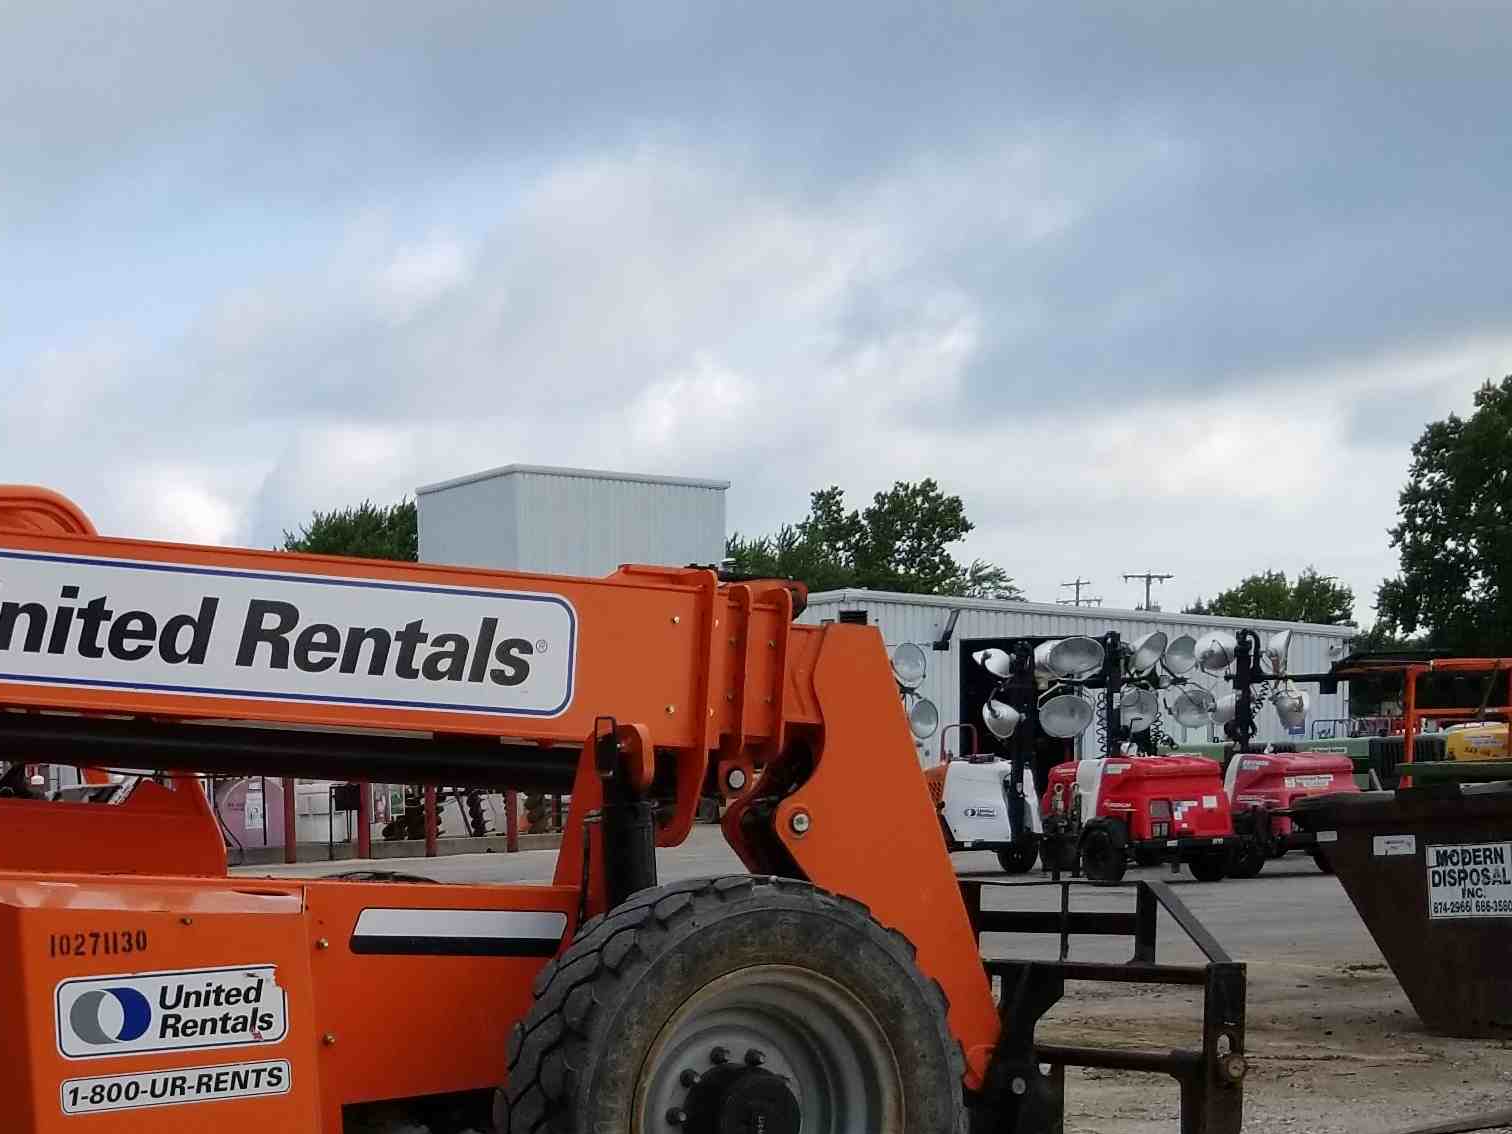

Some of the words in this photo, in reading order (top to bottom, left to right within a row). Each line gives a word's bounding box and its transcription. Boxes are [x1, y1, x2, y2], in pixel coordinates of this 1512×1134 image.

[235, 598, 534, 687] Rentals
[1435, 847, 1505, 867] MODERN
[1431, 866, 1511, 888] DISPOSAL
[1462, 887, 1486, 899] INC.
[49, 929, 148, 958] 10271130
[159, 978, 264, 1010] United
[159, 1006, 274, 1039] Rentals
[68, 1066, 283, 1107] 1-800-UR-RENTS
